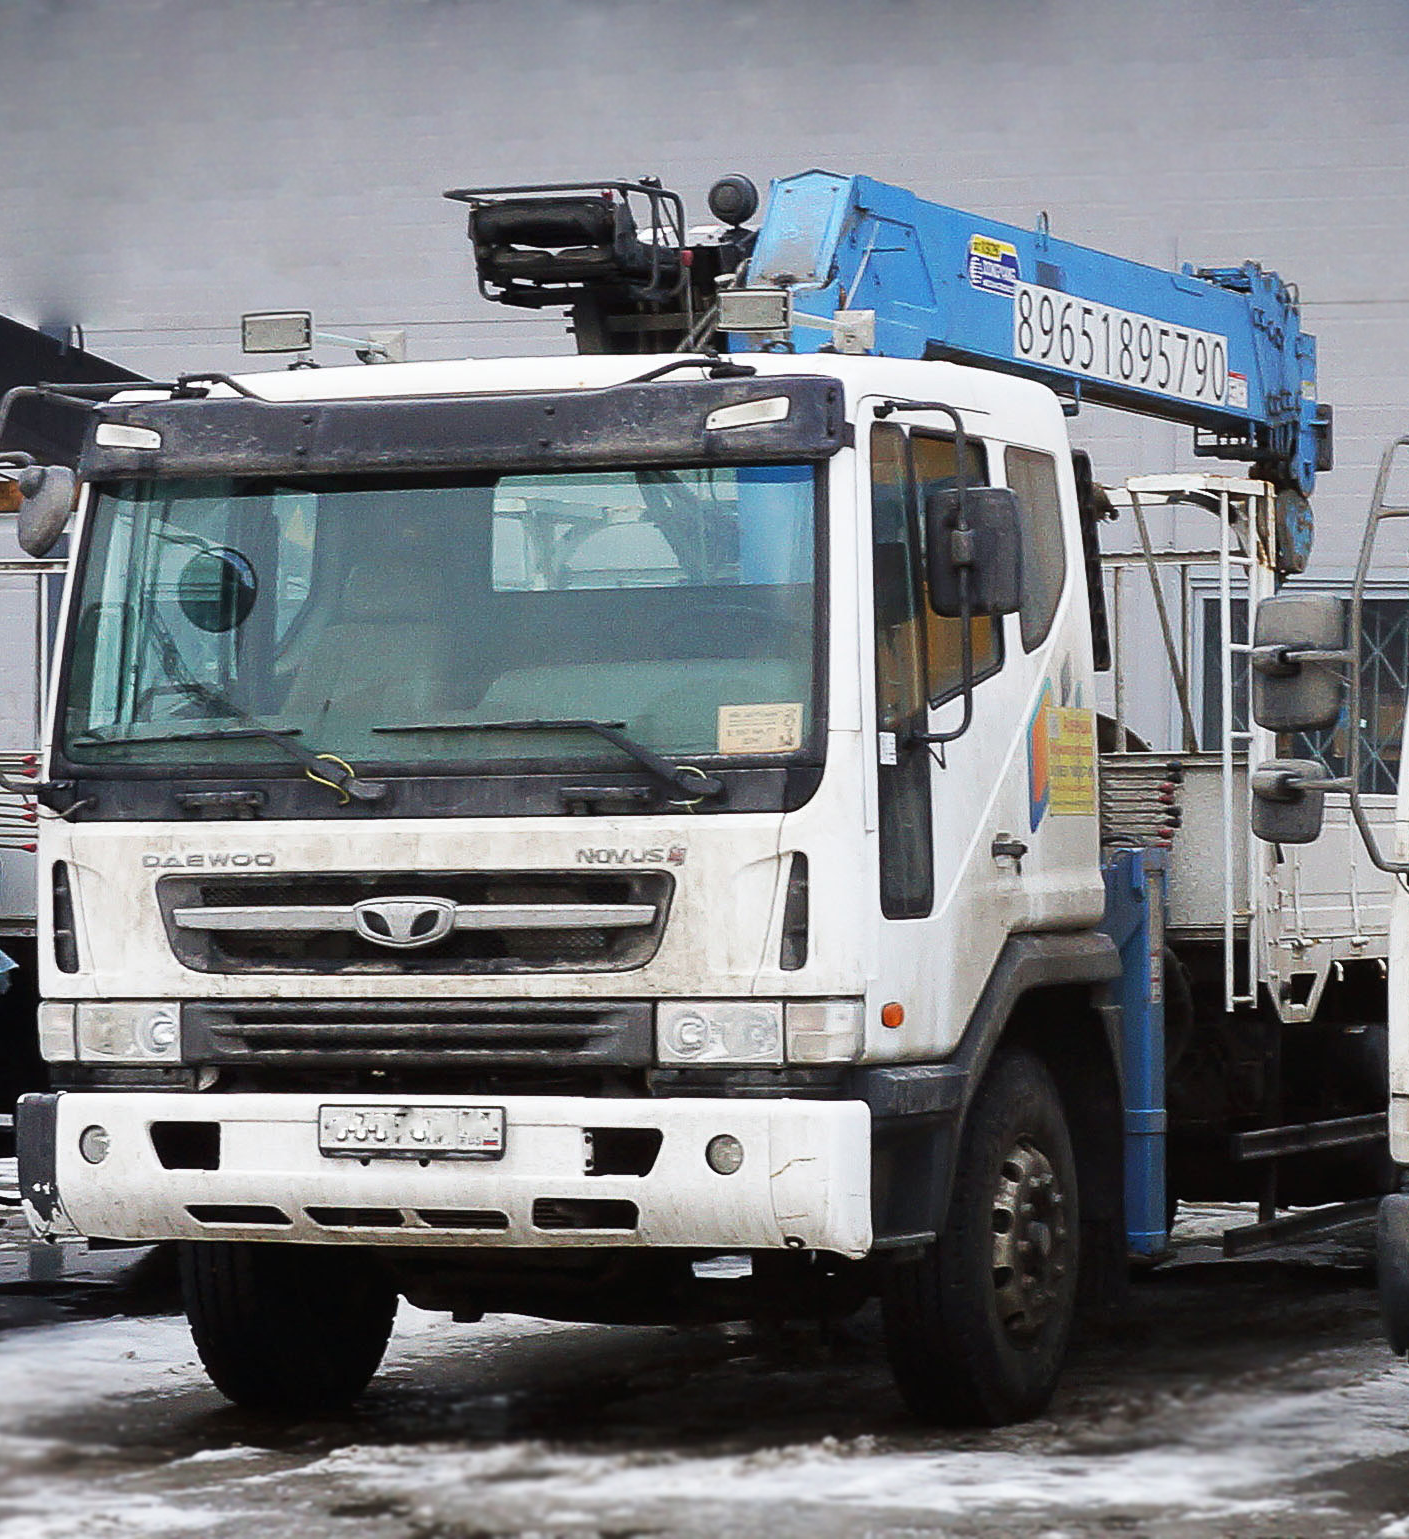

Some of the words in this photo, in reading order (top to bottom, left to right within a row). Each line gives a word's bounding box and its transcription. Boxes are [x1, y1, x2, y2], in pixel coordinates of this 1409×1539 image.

[1018, 289, 1226, 401] 89651895790
[142, 854, 277, 868] DAEWOO
[576, 848, 664, 864] NOVUS
